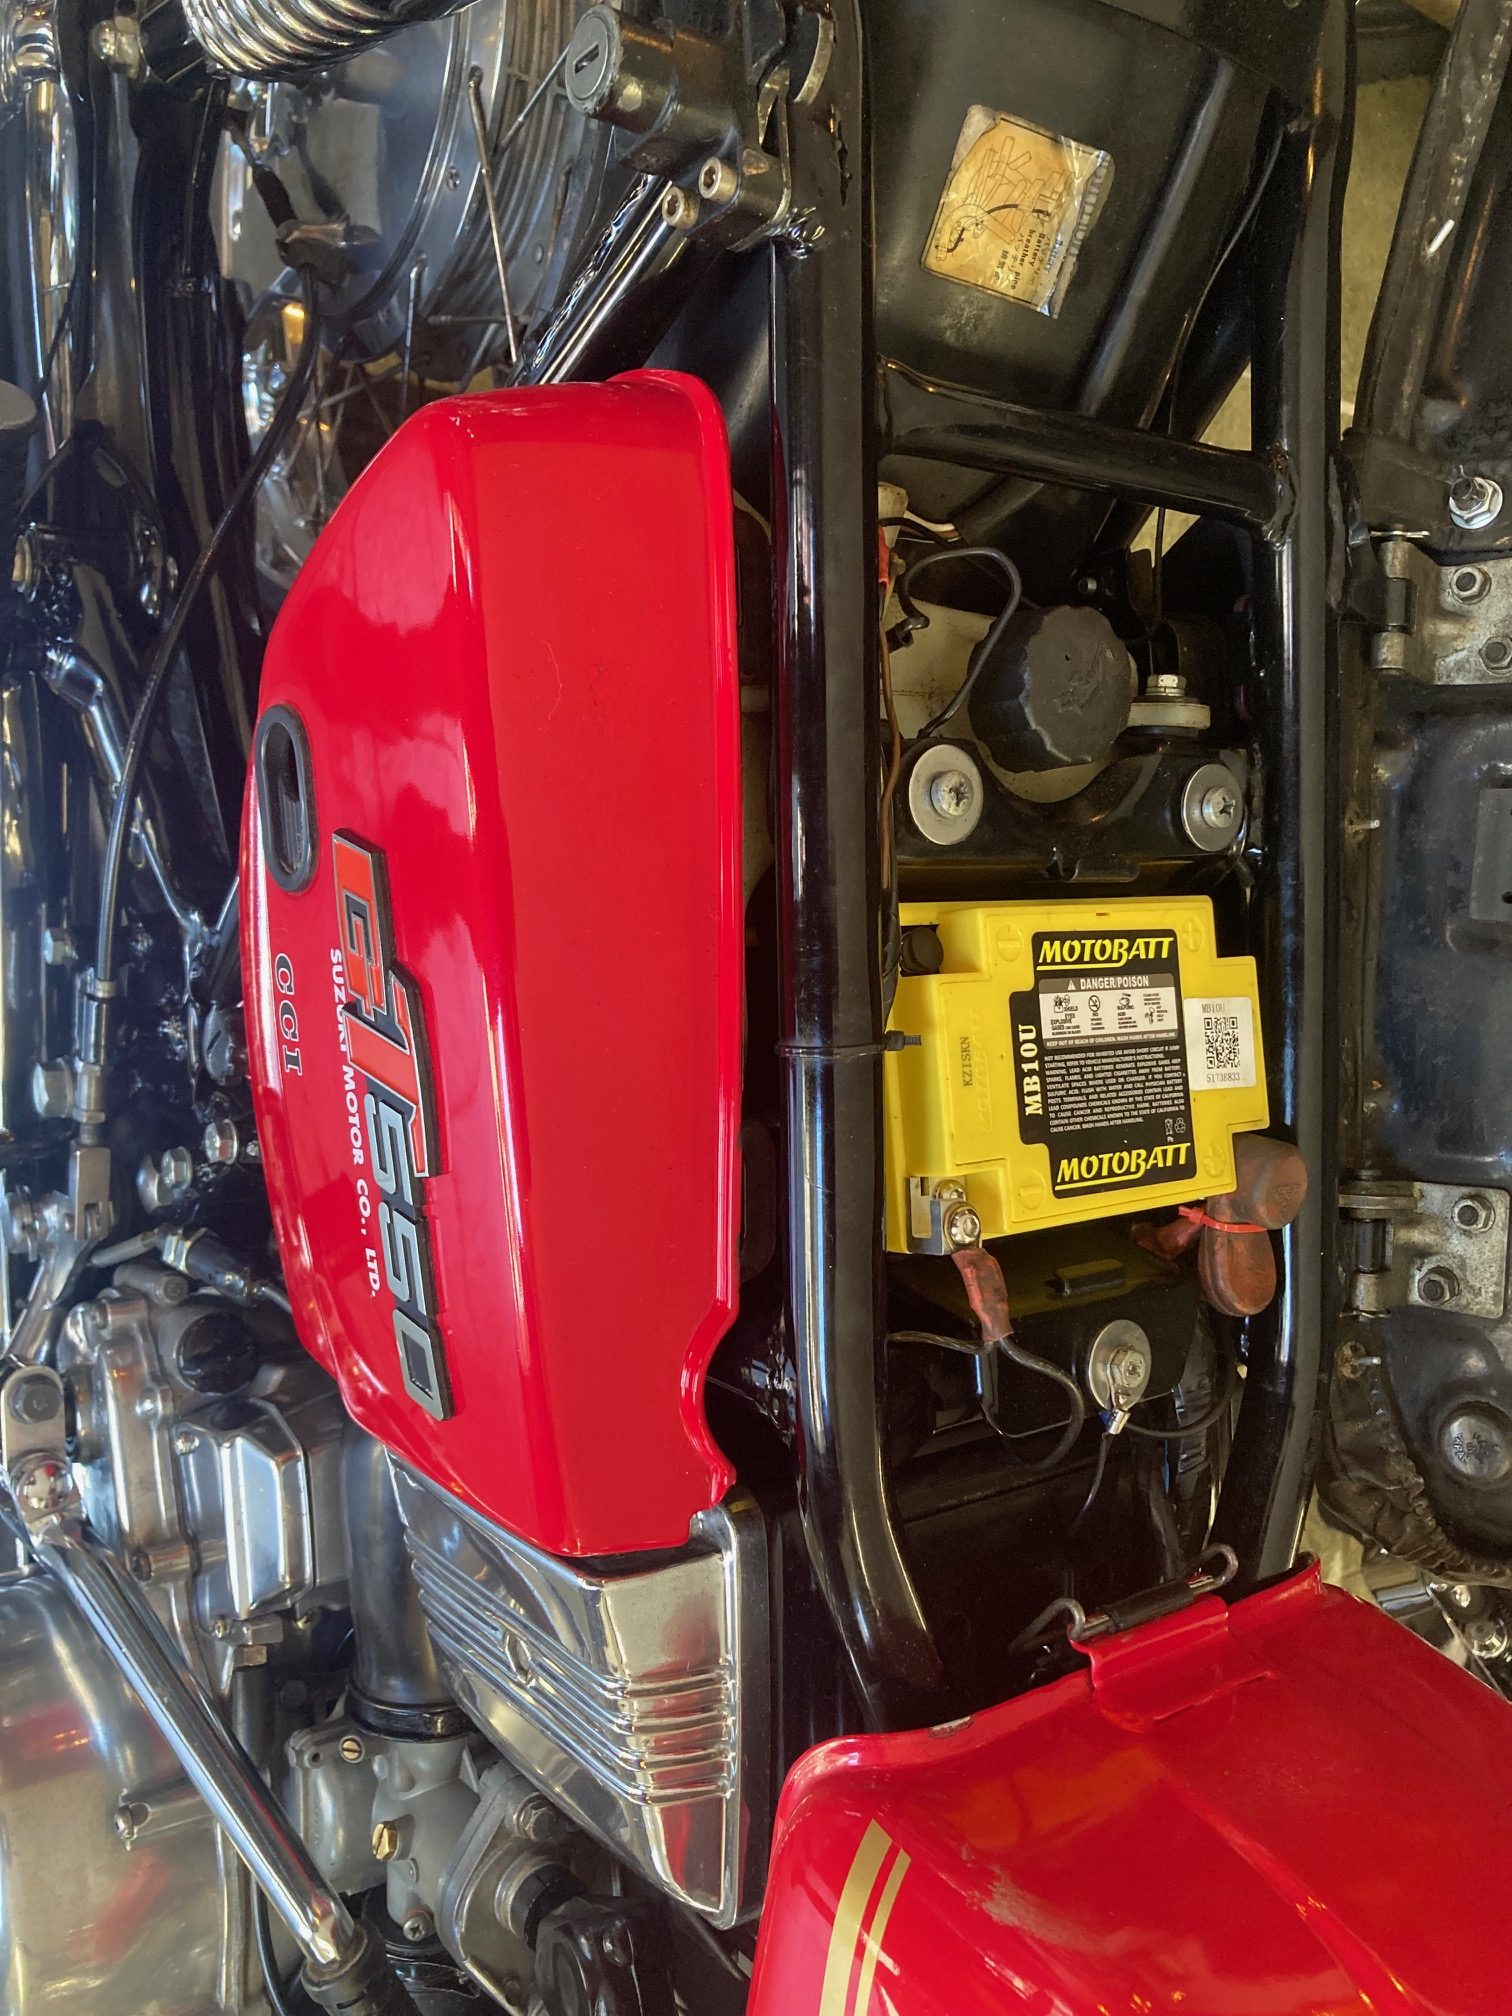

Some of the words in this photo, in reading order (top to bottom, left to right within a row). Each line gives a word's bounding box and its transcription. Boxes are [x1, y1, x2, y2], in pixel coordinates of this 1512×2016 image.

[1019, 229, 1036, 267] breather
[1029, 233, 1045, 266] Battery
[1036, 937, 1174, 971] MOTOBATT
[275, 953, 303, 1076] CCI
[1201, 1003, 1226, 1014] MB10U
[959, 1036, 973, 1087] KZISKN
[1018, 1024, 1043, 1116] MB10U
[342, 1065, 365, 1165] MOTOR
[365, 1247, 381, 1298] LTD.
[1054, 1142, 1191, 1191] MOTOBATT
